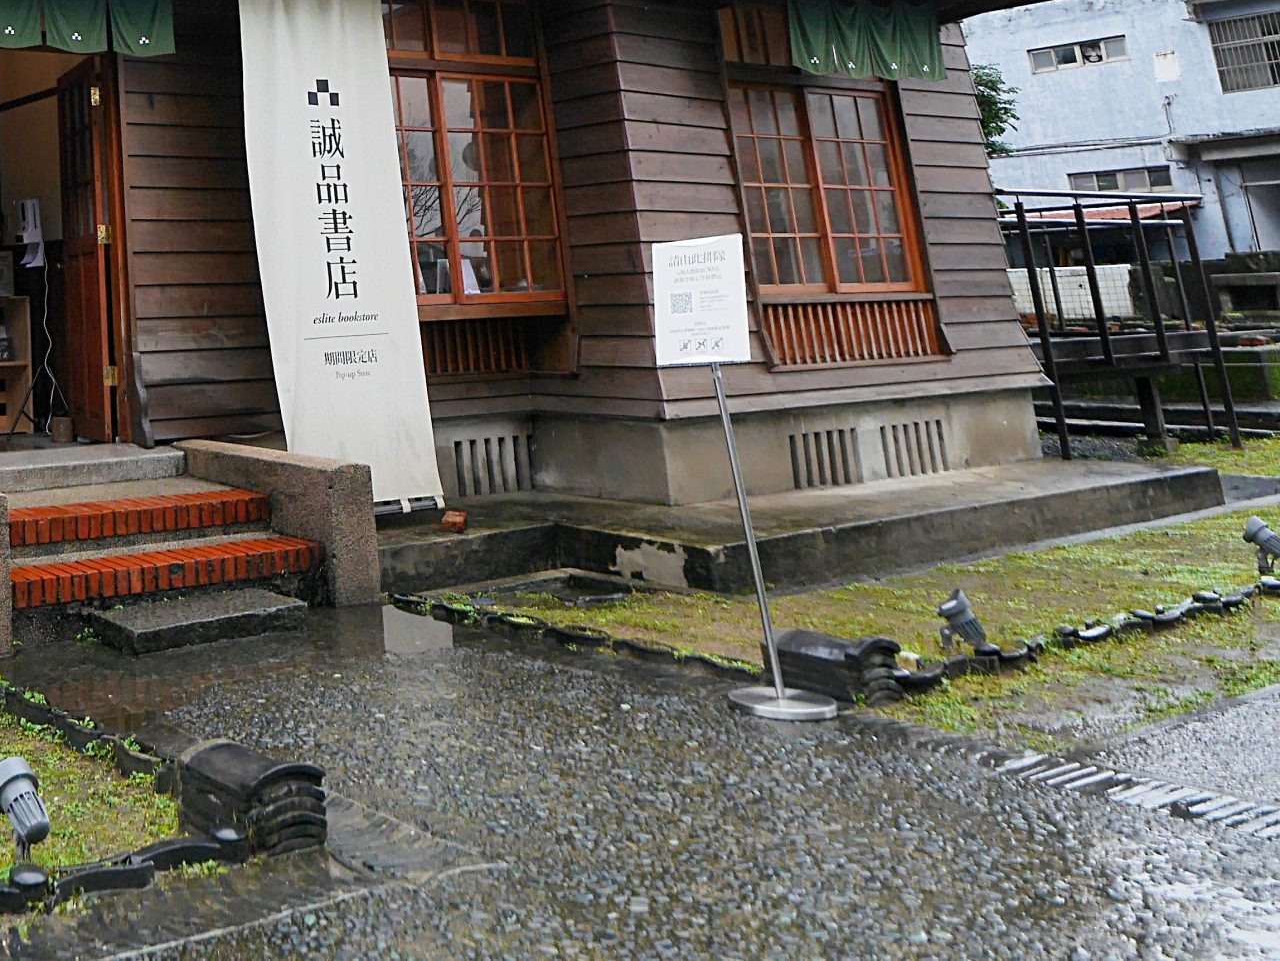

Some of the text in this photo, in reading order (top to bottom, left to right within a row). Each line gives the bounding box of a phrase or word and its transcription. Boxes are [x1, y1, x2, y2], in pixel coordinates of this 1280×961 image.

[310, 117, 358, 299] 誠品書店
[313, 310, 379, 325] eslite bookstore
[324, 348, 378, 366] 期間限定店
[335, 369, 371, 380] Pop-up Store
